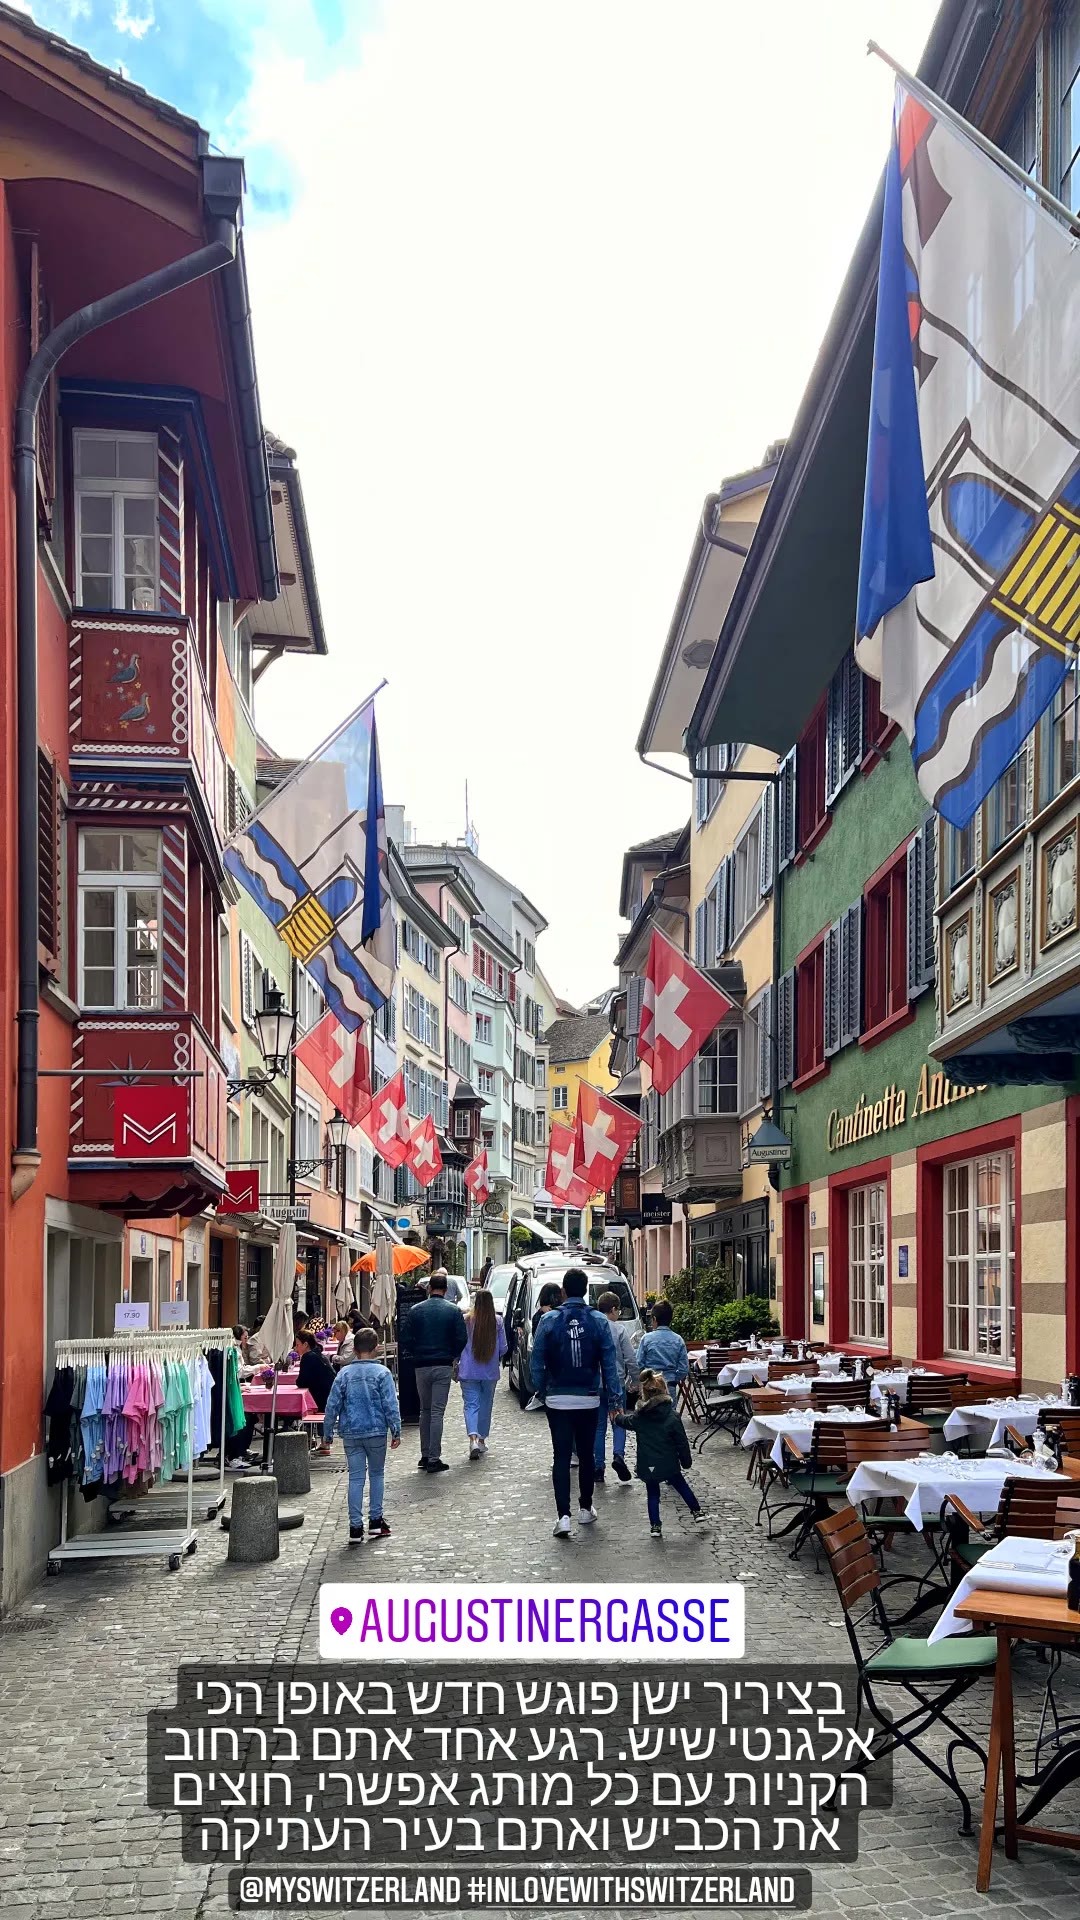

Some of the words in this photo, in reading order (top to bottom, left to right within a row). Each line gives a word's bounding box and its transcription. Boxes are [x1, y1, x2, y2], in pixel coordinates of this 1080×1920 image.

[827, 1082, 906, 1152] Cantinetta
[752, 1149, 788, 1158] Augustiner
[270, 1208, 308, 1218] Augustin
[643, 1210, 671, 1218] meister
